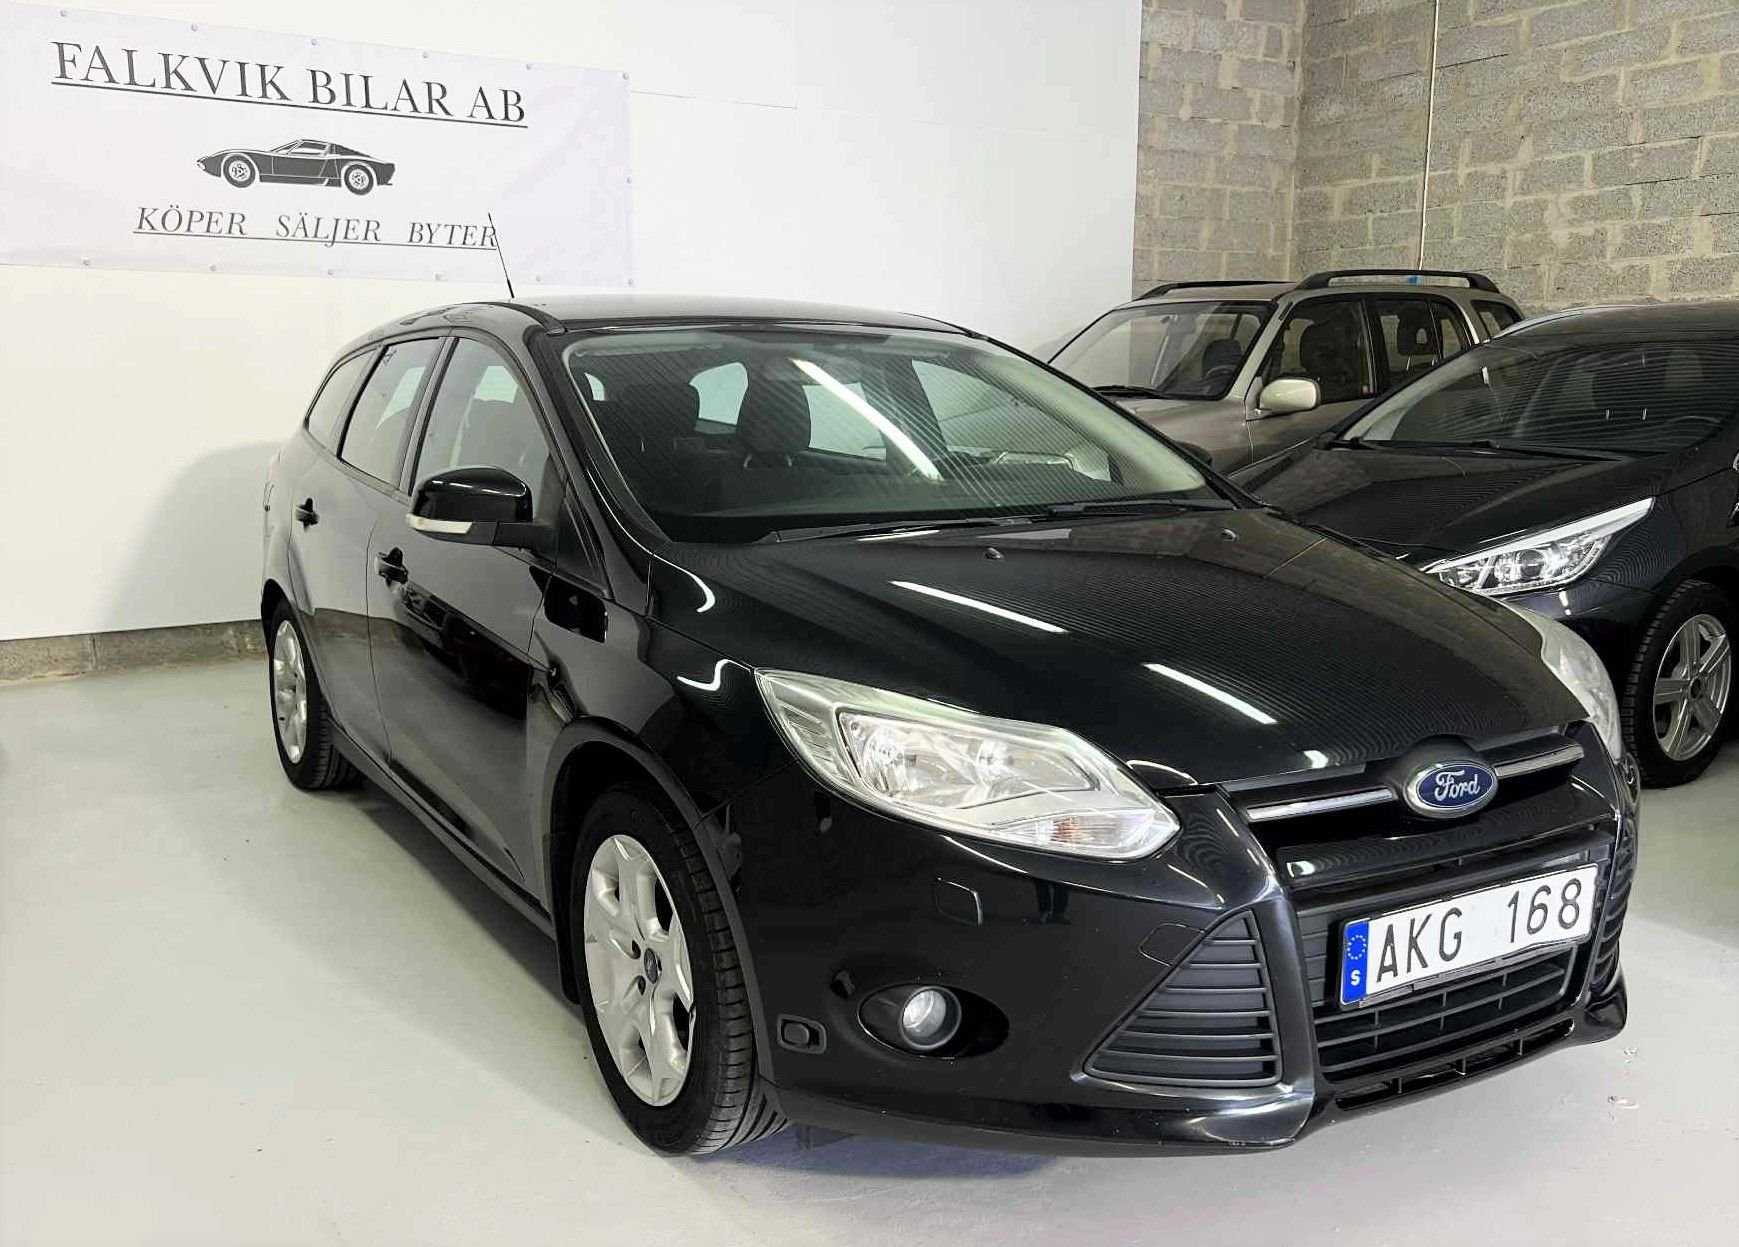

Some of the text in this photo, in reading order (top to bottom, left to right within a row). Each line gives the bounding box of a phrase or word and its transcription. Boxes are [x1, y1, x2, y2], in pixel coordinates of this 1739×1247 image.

[53, 41, 527, 123] FALKVIK BILAR AB
[136, 205, 498, 249] KÖPER SÄLJER BYTER
[1434, 770, 1481, 800] Ford
[1377, 877, 1583, 982] AKG 168
[1350, 969, 1361, 986] S
